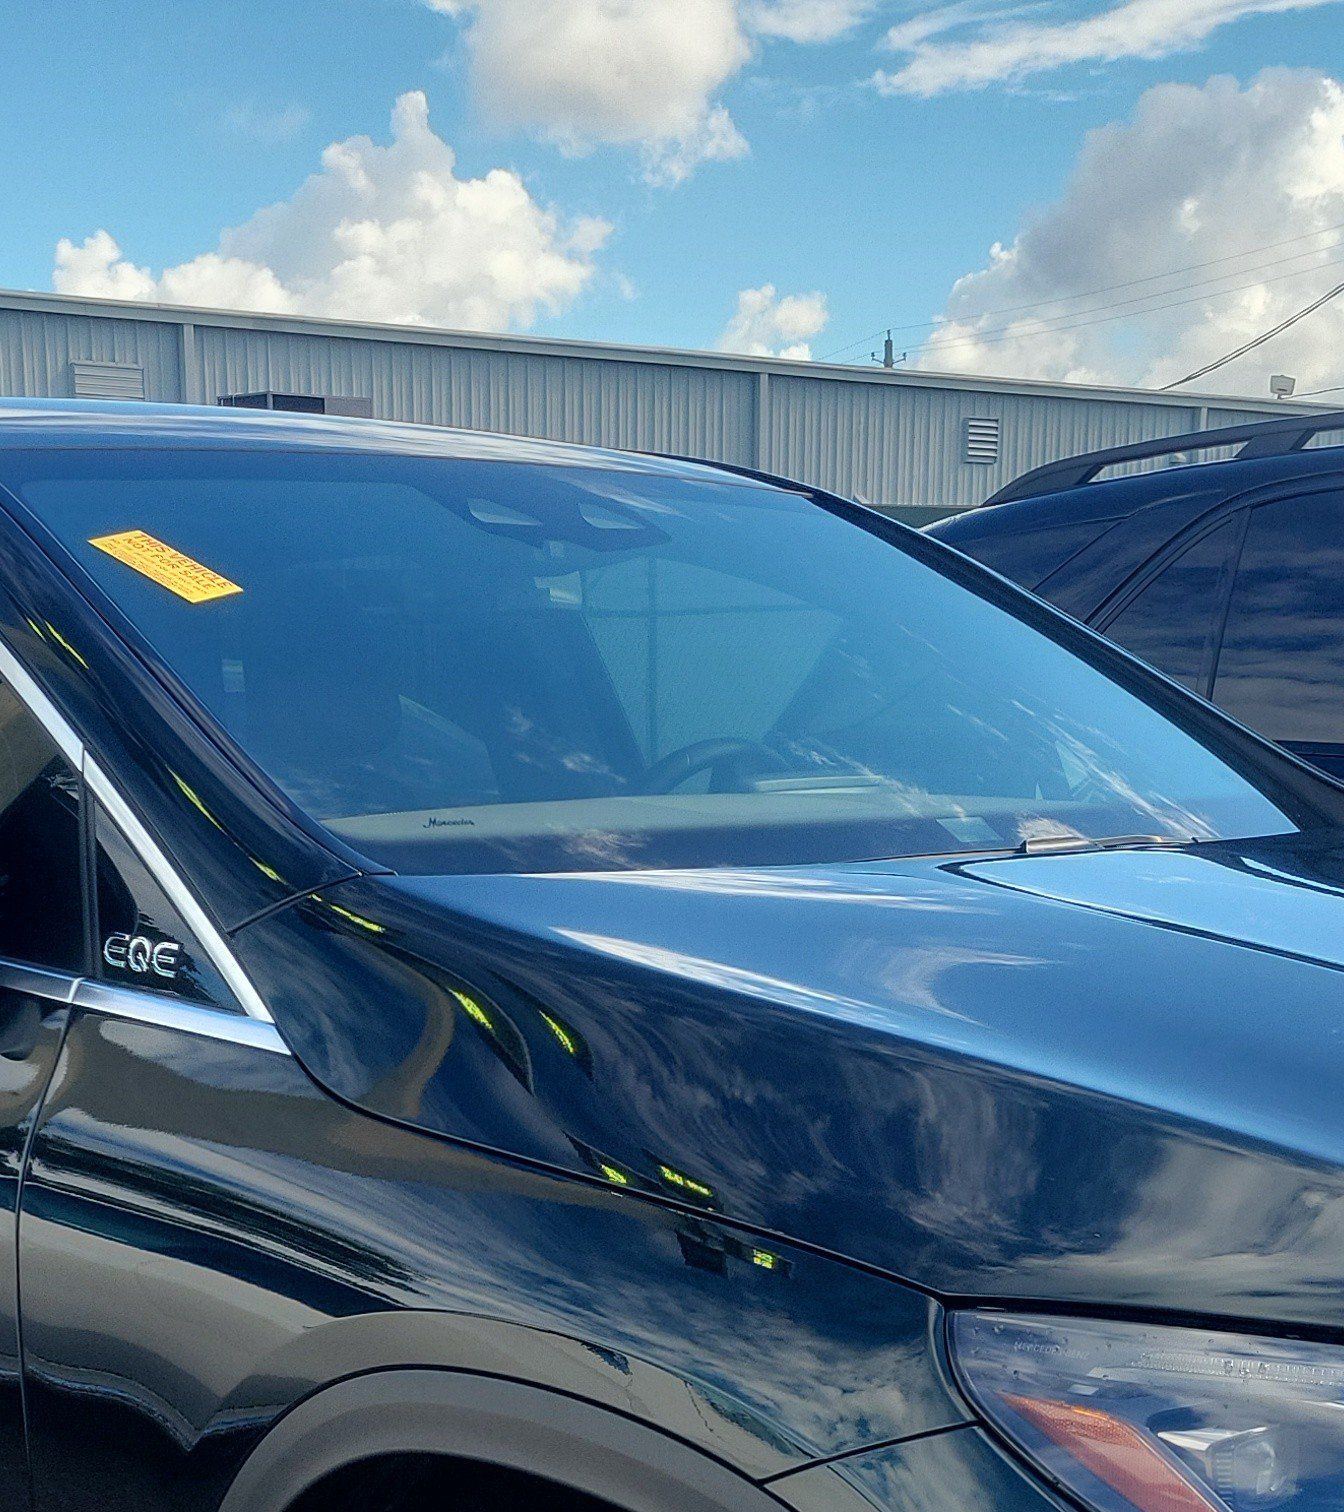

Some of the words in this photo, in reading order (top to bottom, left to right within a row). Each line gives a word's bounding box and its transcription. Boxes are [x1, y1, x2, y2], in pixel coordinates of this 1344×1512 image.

[169, 551, 233, 589] VEHICLE
[180, 569, 216, 590] SALE
[103, 931, 179, 979] EQE
